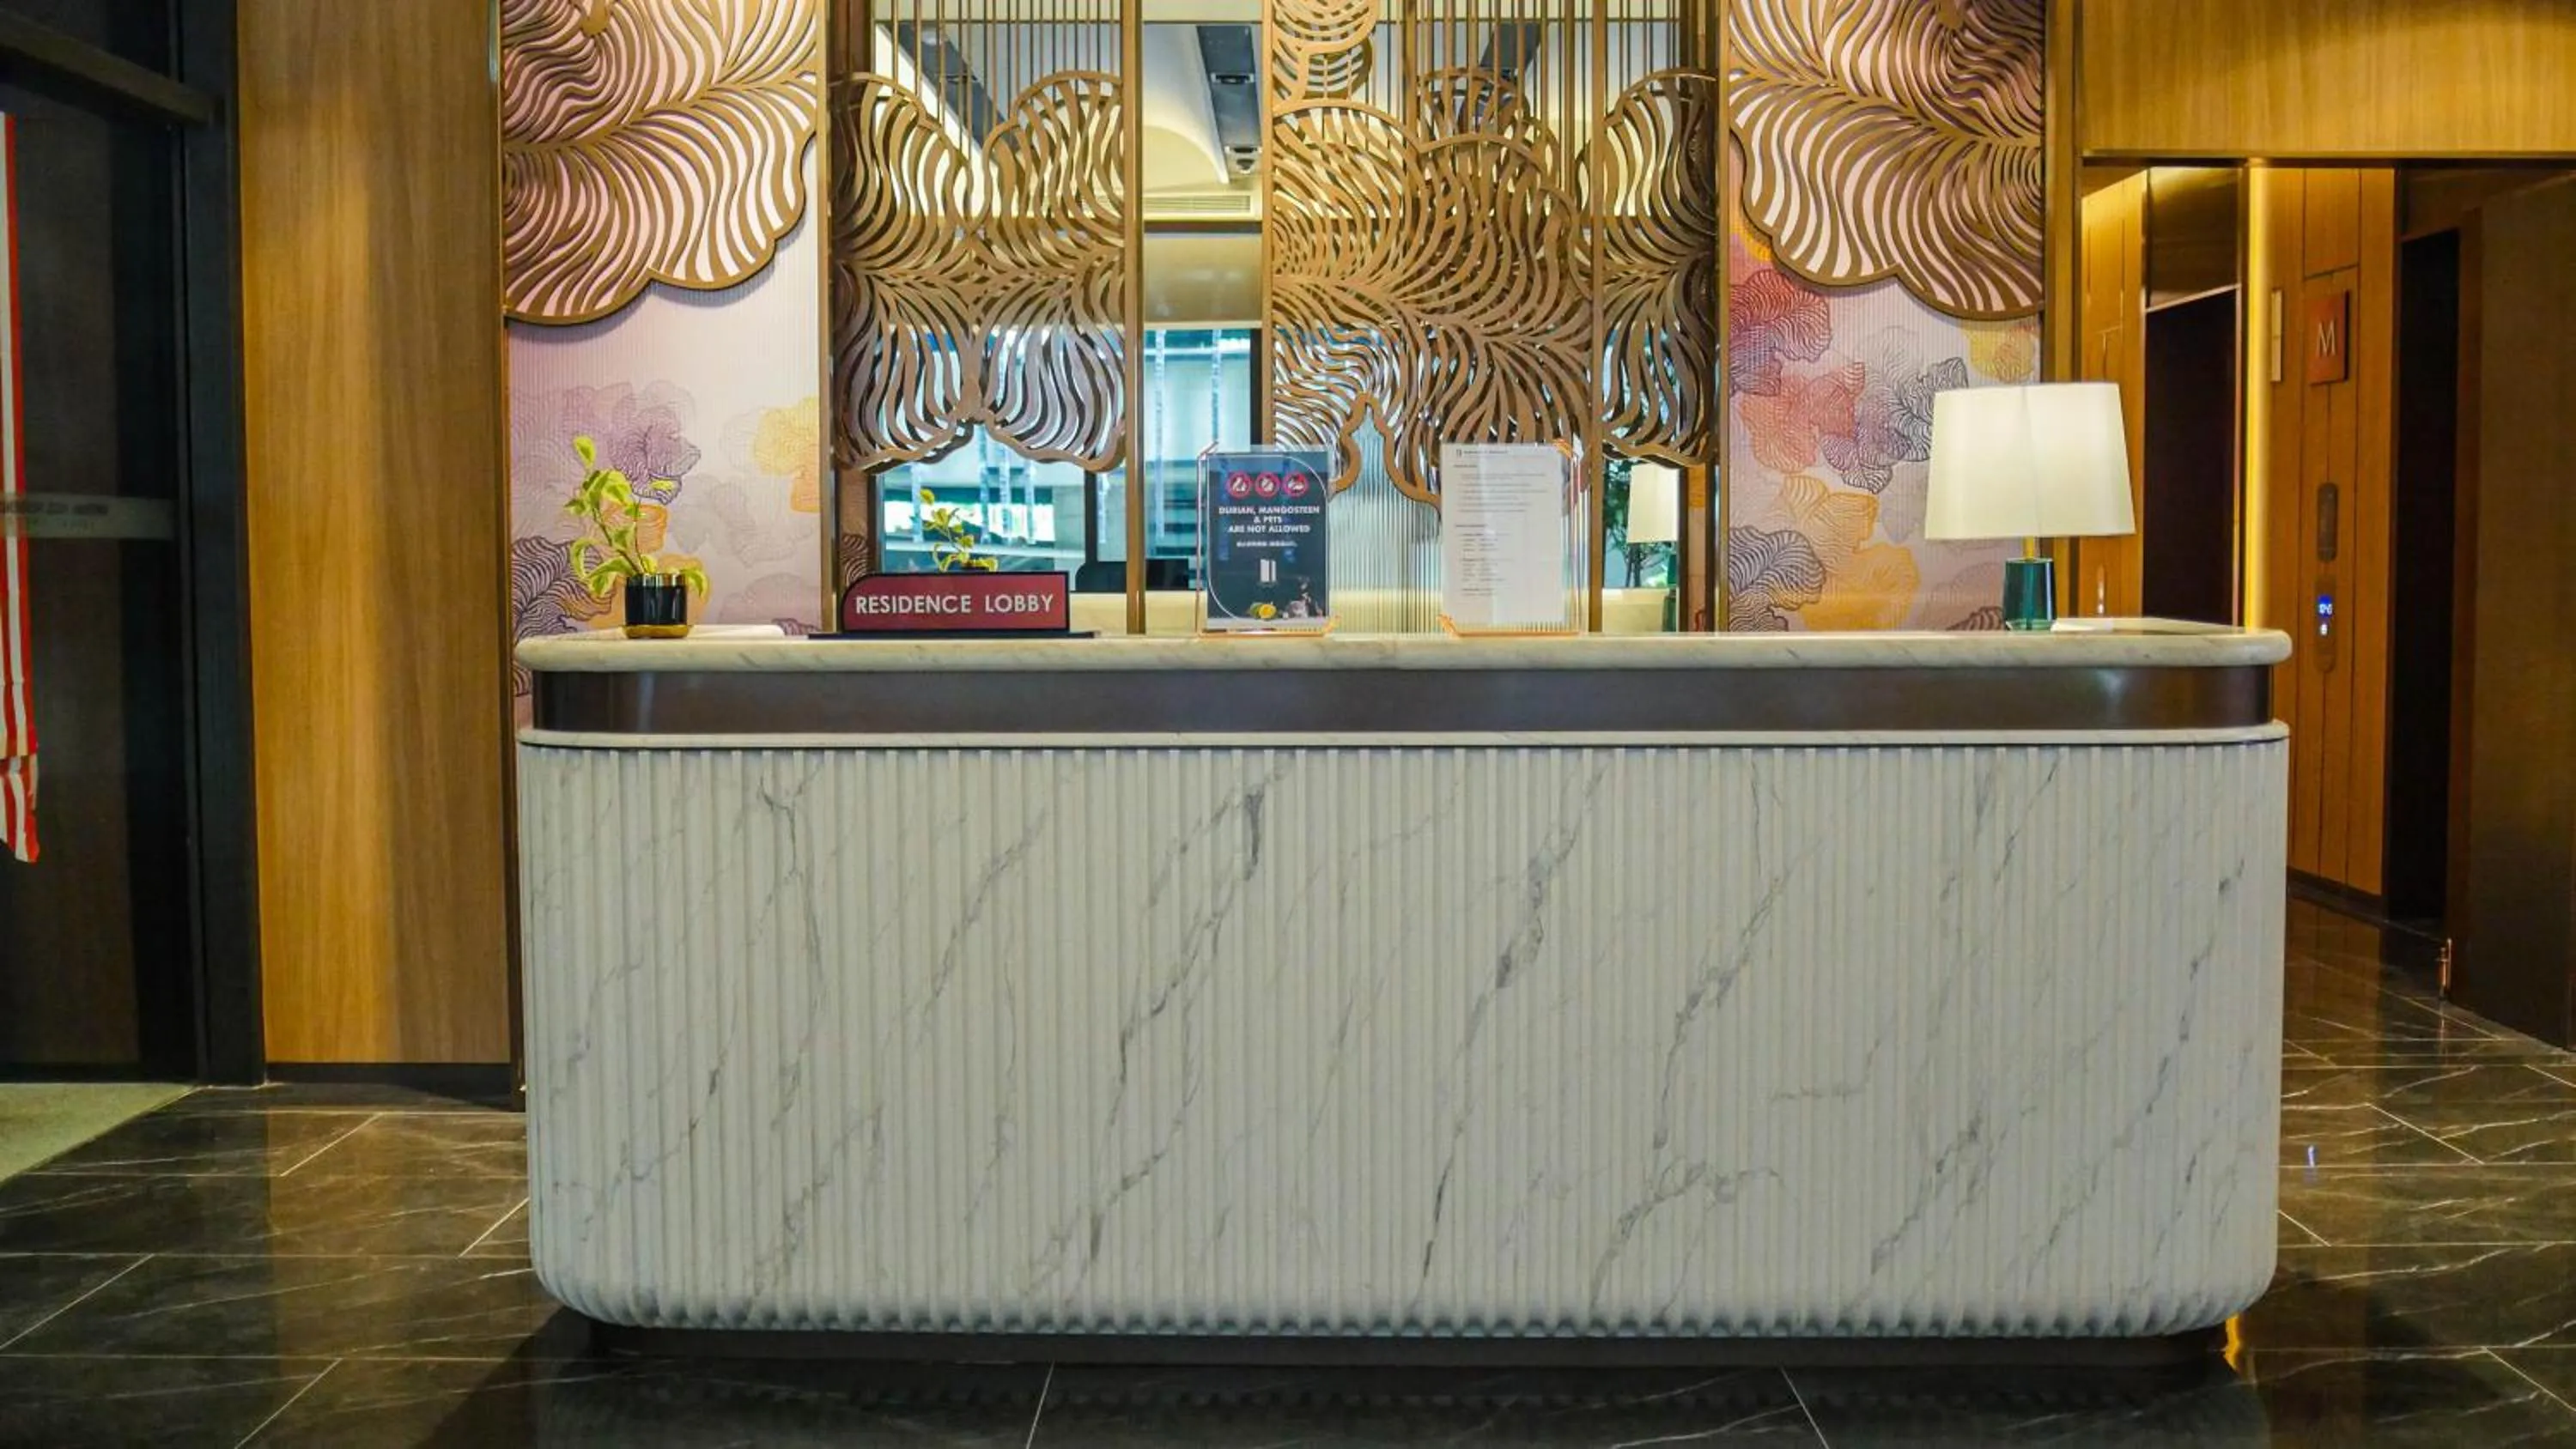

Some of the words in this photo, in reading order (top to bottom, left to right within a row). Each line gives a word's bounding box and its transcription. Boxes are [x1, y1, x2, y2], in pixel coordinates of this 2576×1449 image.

[2316, 320, 2336, 356] M
[1218, 505, 1256, 515] DURIAN,
[1259, 505, 1320, 514] MANGOSTEEN
[1228, 524, 1245, 533] ARE
[1247, 524, 1266, 533] NOT
[1268, 524, 1311, 533] ALLOWED
[855, 595, 972, 614] RESIDENCE
[985, 594, 1054, 613] LOBBY
